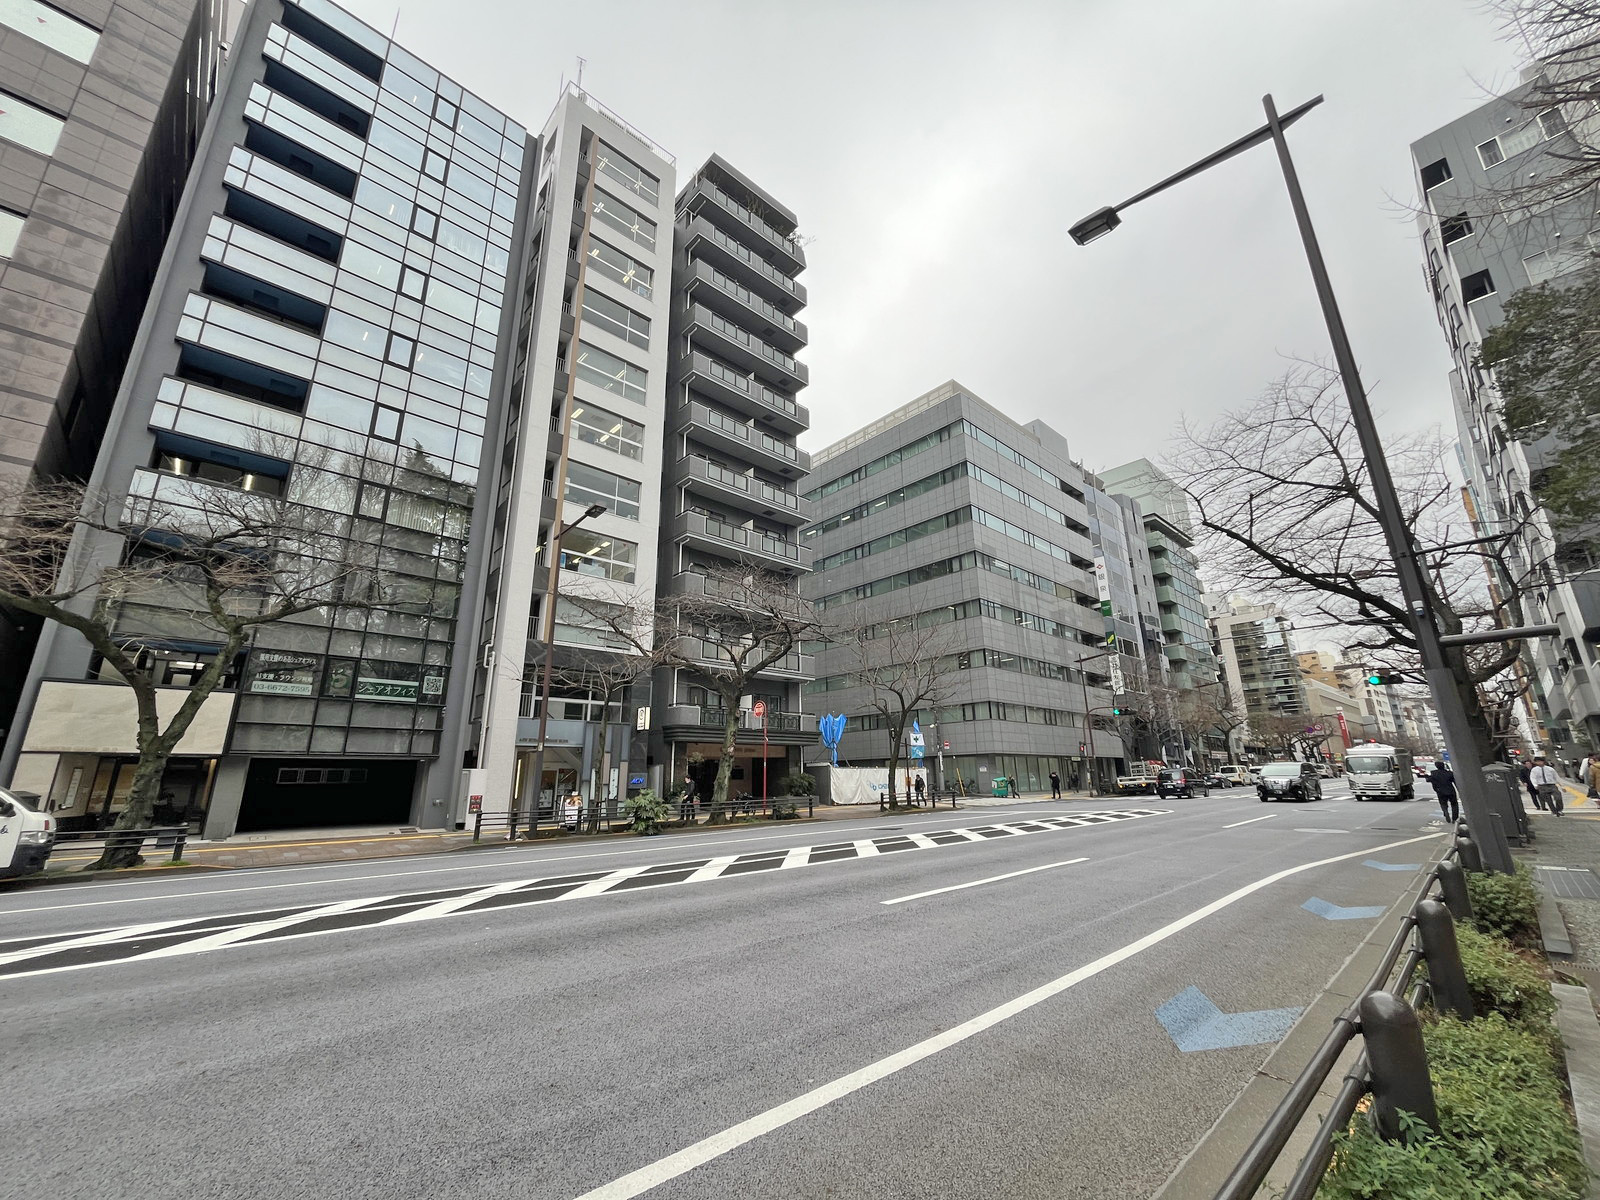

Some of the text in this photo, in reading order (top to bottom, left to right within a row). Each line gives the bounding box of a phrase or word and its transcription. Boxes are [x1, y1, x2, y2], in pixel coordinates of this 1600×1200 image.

[358, 683, 416, 696] シェアオフィス
